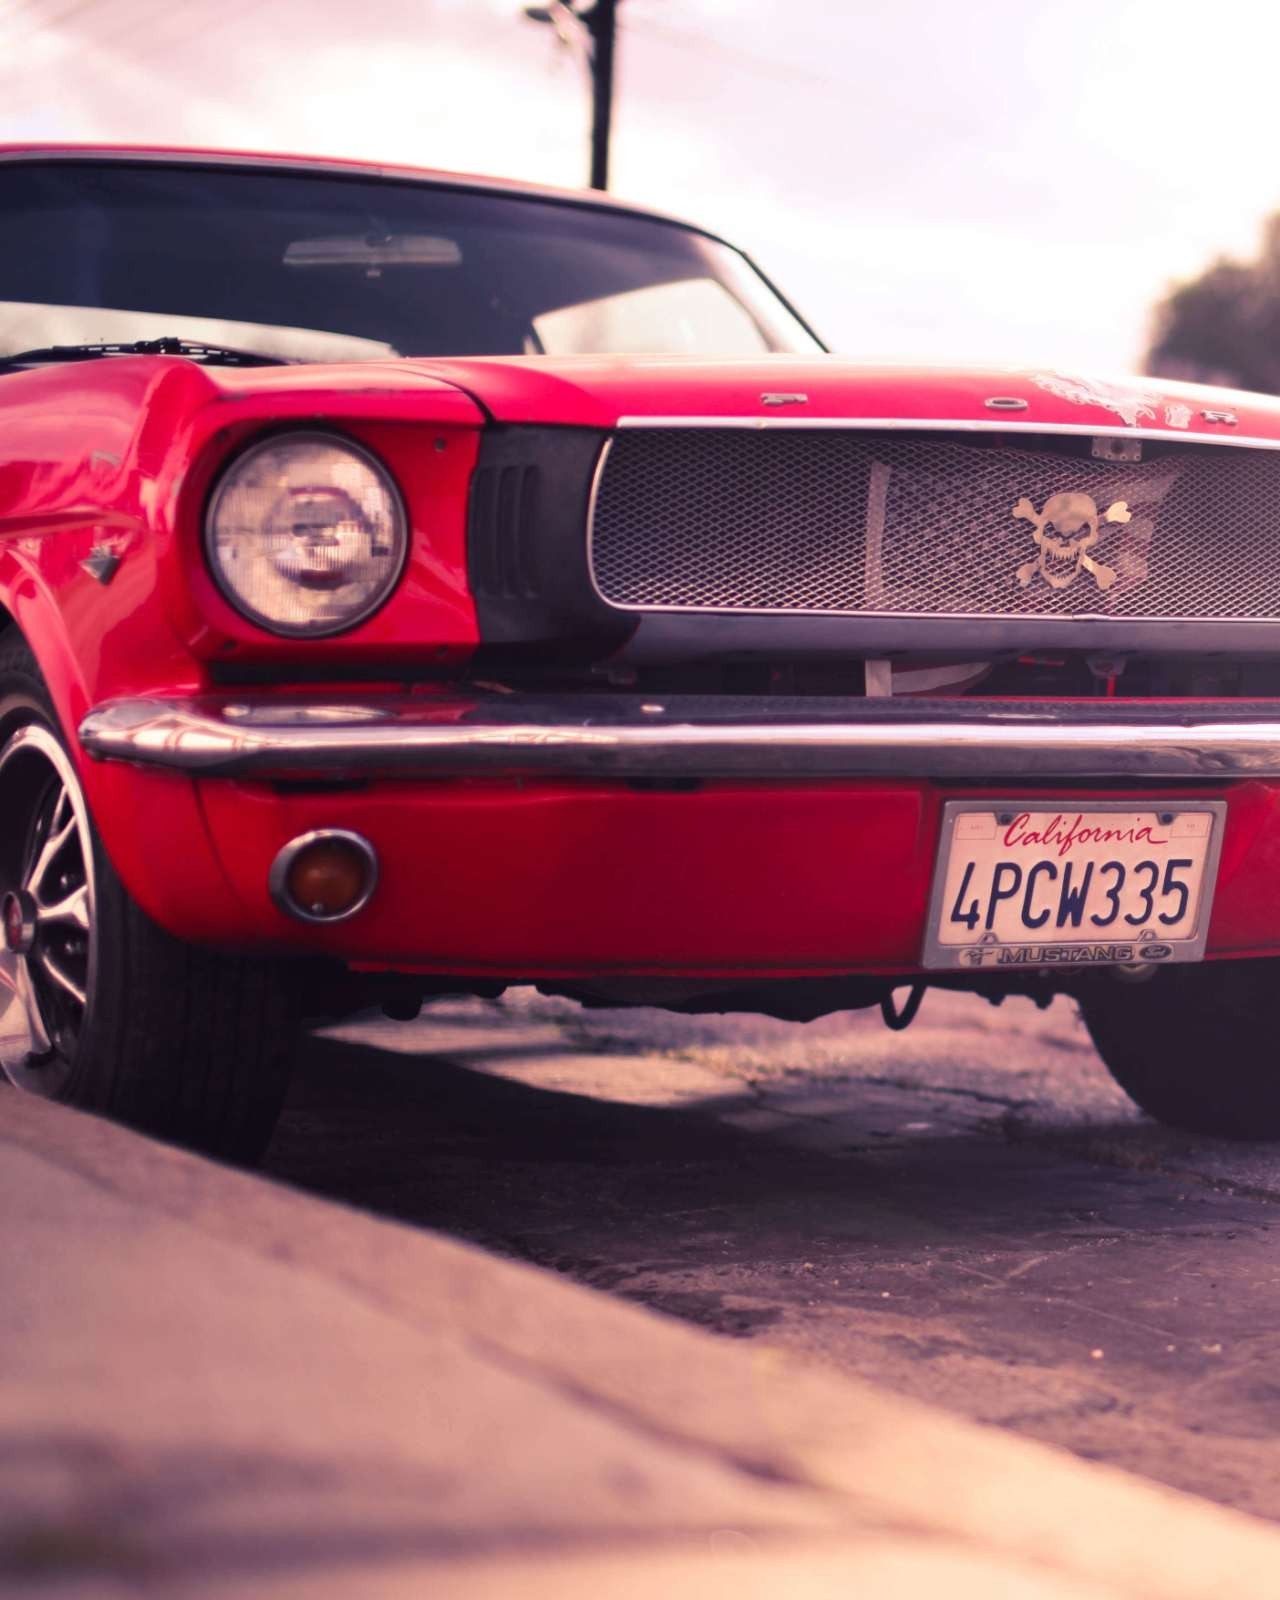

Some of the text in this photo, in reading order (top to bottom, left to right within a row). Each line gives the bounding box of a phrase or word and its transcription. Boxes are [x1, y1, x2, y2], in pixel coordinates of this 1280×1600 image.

[1003, 813, 1168, 857] California
[950, 858, 1193, 930] 4PCW335
[999, 944, 1135, 964] MUSTANG
